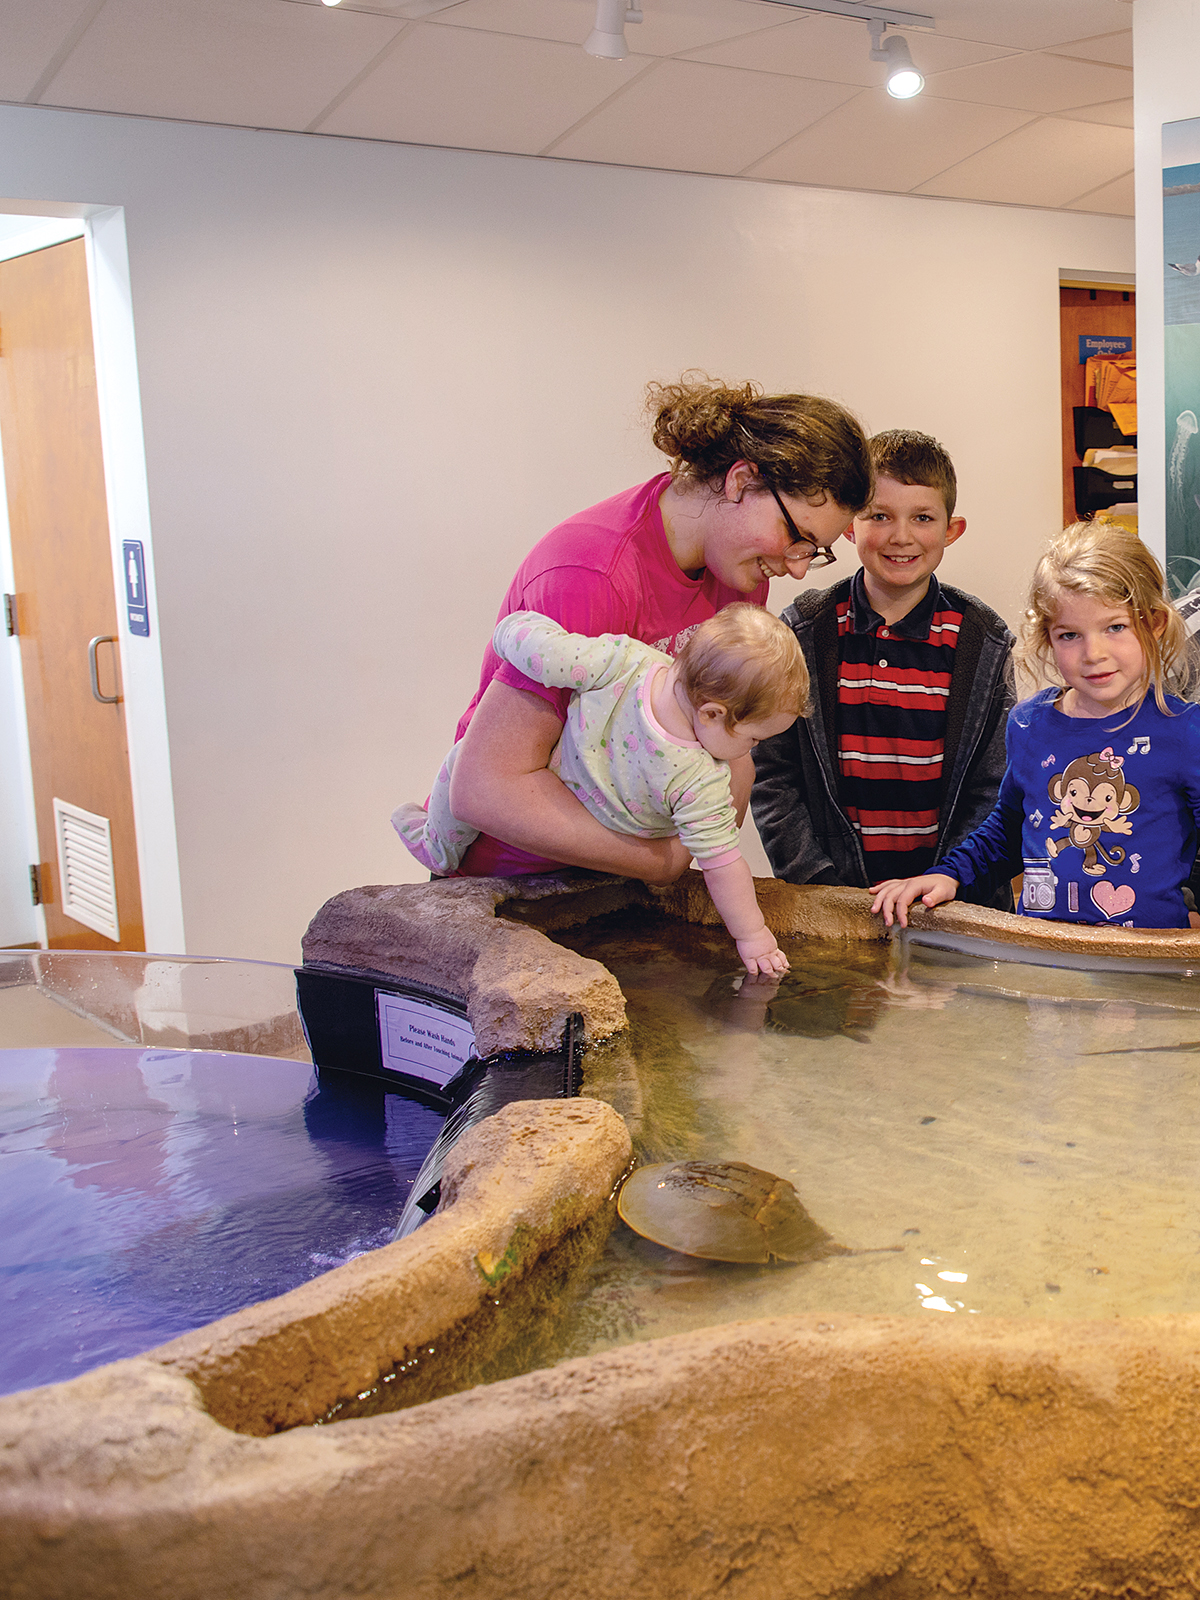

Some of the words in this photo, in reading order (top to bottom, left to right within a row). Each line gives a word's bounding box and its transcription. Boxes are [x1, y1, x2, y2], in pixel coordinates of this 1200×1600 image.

[1086, 339, 1127, 350] Employees
[400, 1035, 414, 1045] Before
[423, 1042, 433, 1051] After
[433, 1045, 450, 1058] Touching
[408, 1024, 426, 1036] Please
[426, 1029, 440, 1041] Wash
[440, 1034, 456, 1047] Hands
